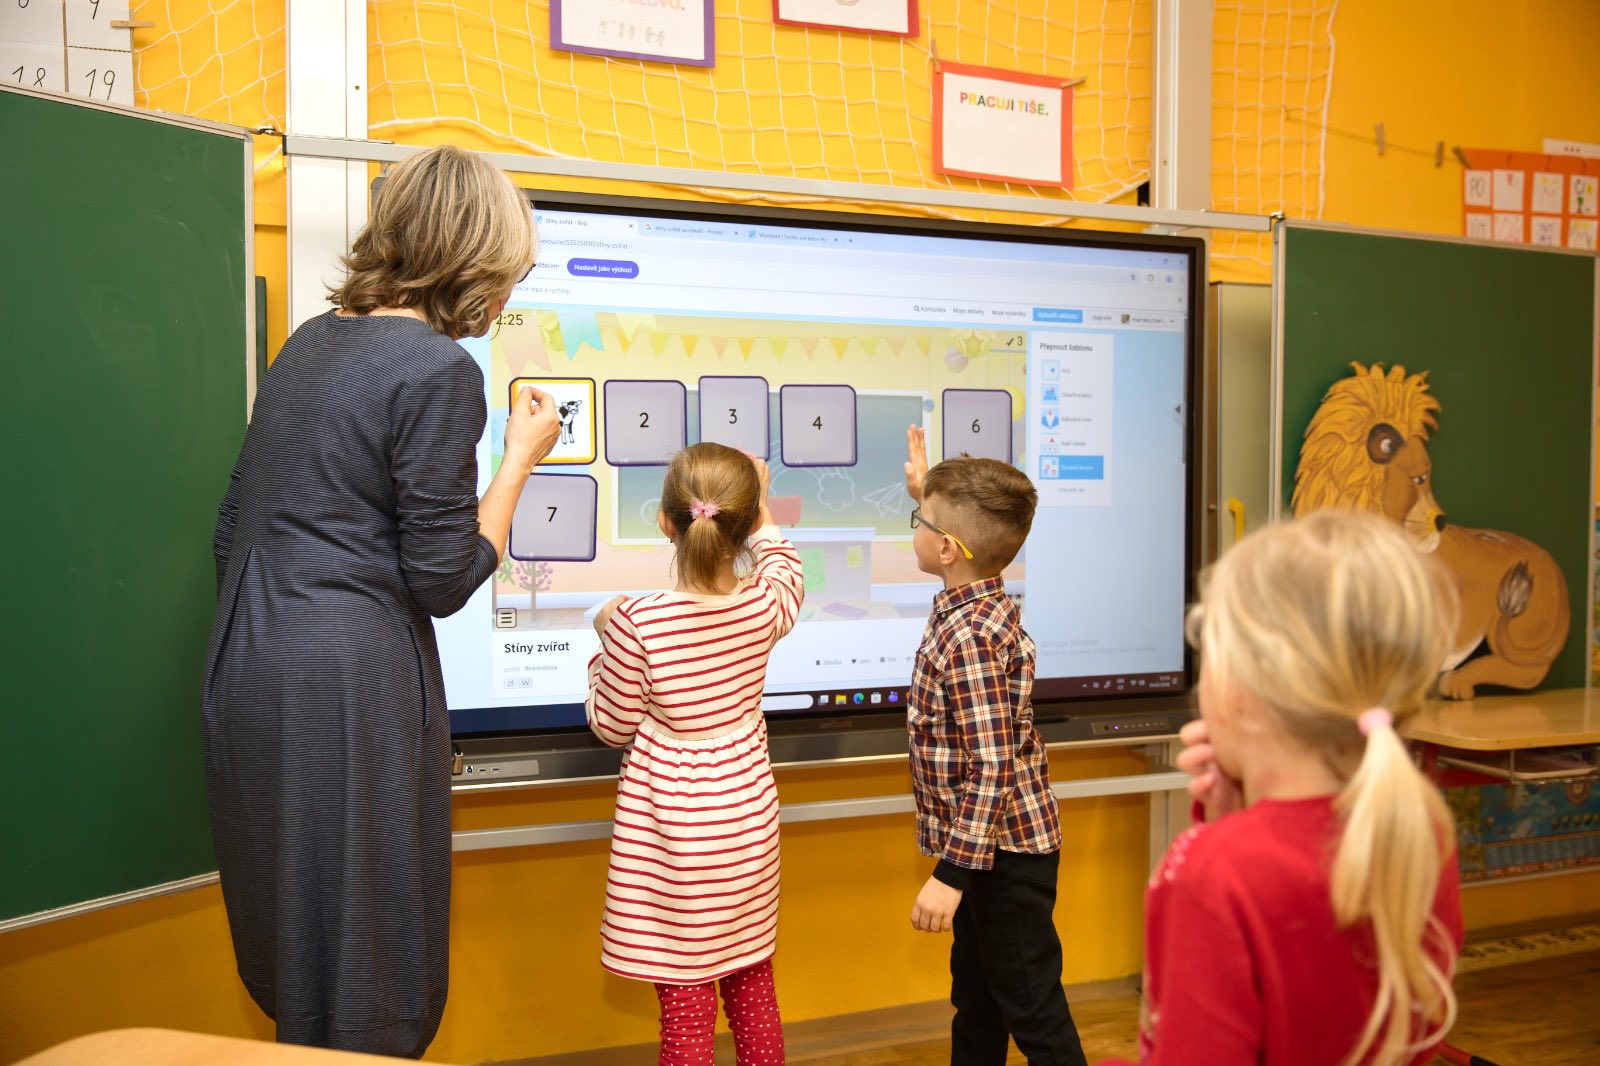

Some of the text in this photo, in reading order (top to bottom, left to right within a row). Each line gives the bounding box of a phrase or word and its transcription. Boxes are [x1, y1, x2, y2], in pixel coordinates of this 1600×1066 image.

[12, 65, 116, 101] 18 19
[960, 91, 1049, 116] PRACUJI TIŠE.
[574, 263, 598, 272] Nastavit
[598, 264, 611, 274] jako
[1016, 335, 1024, 347] 3
[639, 408, 981, 434] 2 3 4 6
[547, 506, 558, 522] 7
[504, 641, 570, 655] Stíny zvířat
